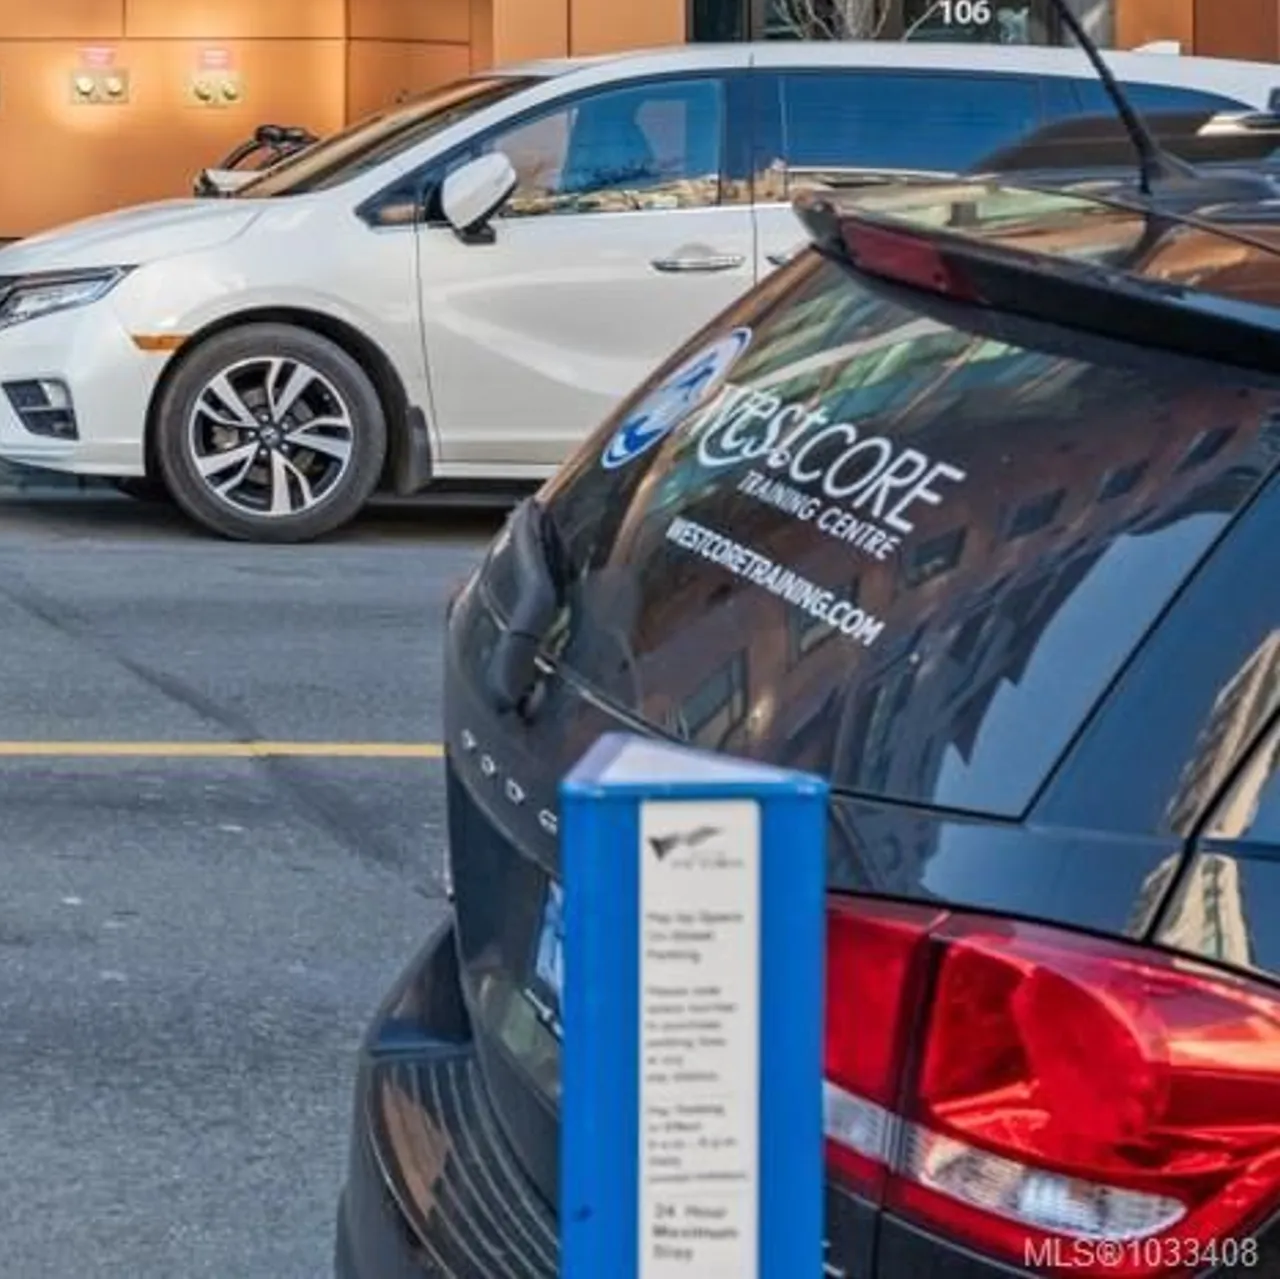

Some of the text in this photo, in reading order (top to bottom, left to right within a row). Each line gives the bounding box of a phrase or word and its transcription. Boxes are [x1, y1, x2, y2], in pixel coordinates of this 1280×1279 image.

[737, 469, 902, 561] TRAINING CENTRE
[666, 516, 886, 647] WESTCORETRAINING.COM
